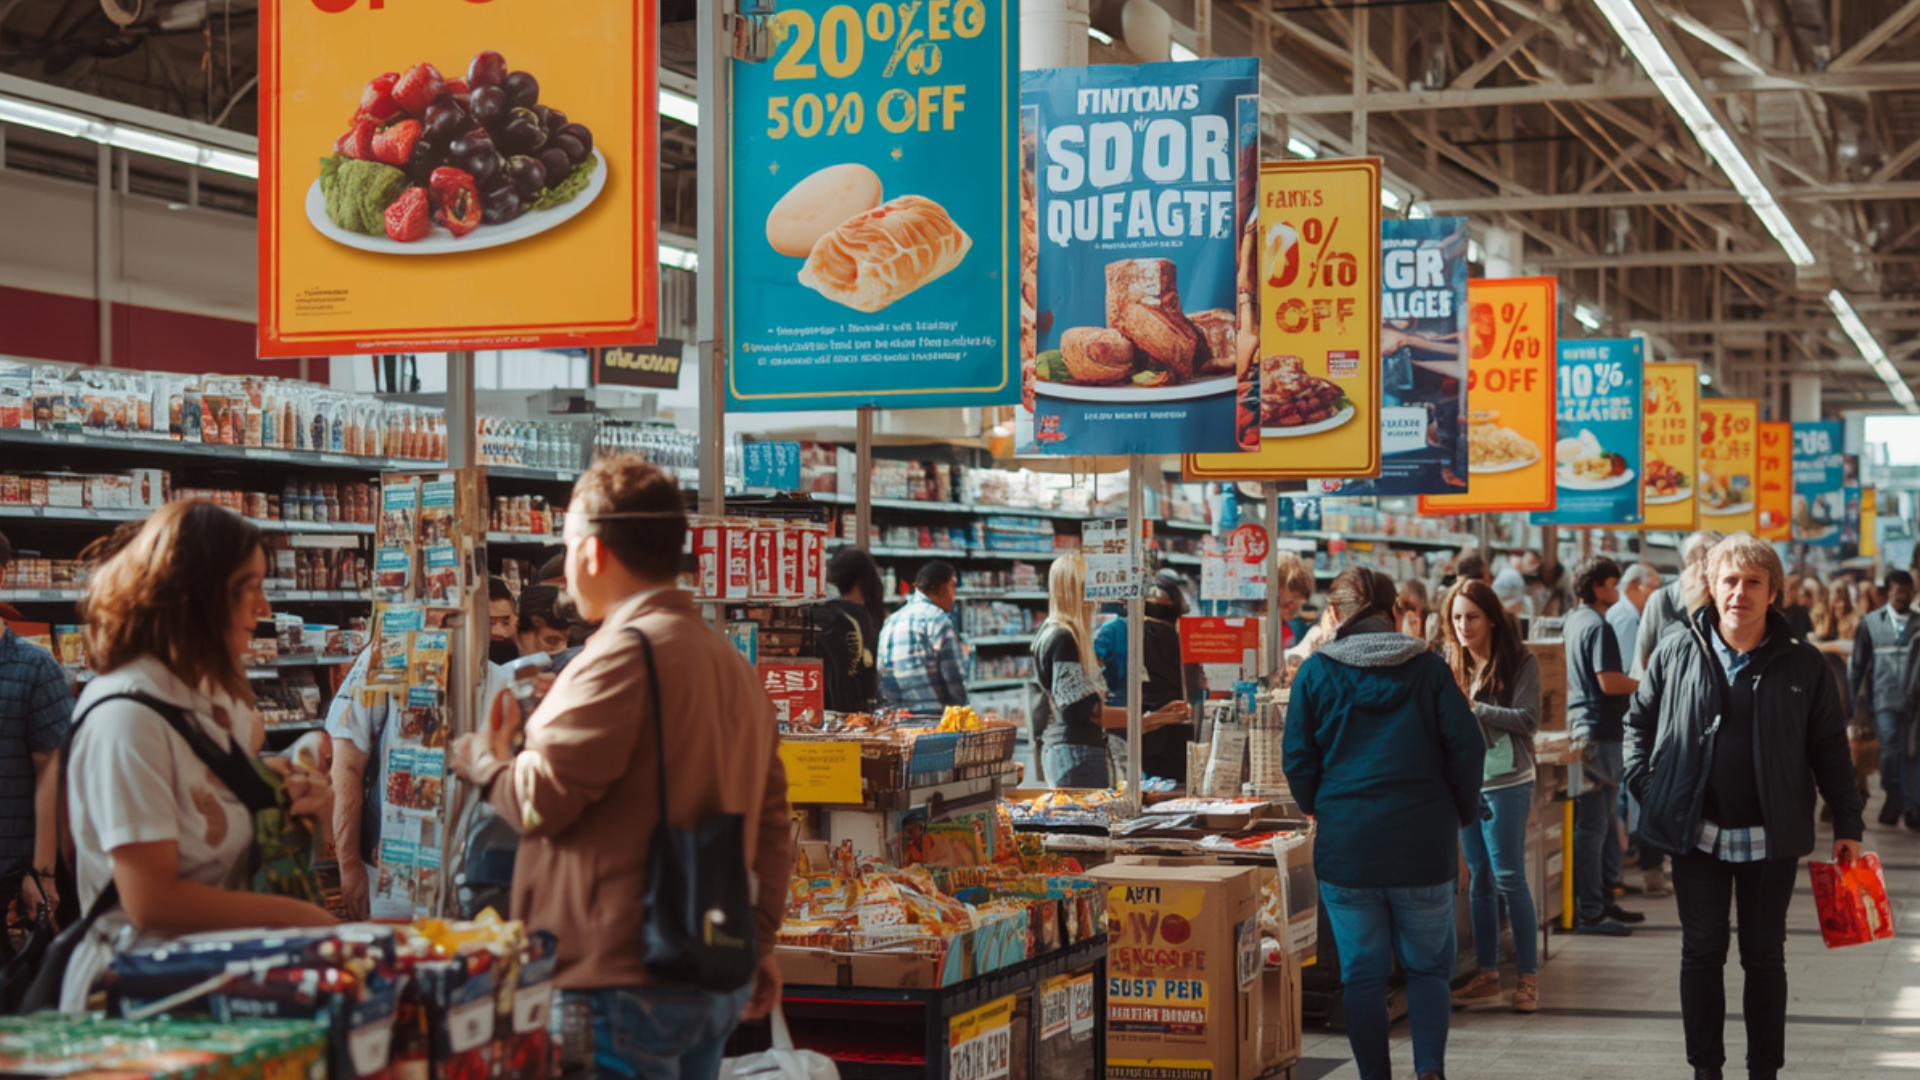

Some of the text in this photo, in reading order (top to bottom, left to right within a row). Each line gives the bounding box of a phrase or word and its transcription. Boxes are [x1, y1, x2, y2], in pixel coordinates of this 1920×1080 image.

[877, 84, 966, 134] OFF
[1275, 297, 1356, 335] OFF
[1484, 367, 1538, 393] OFF
